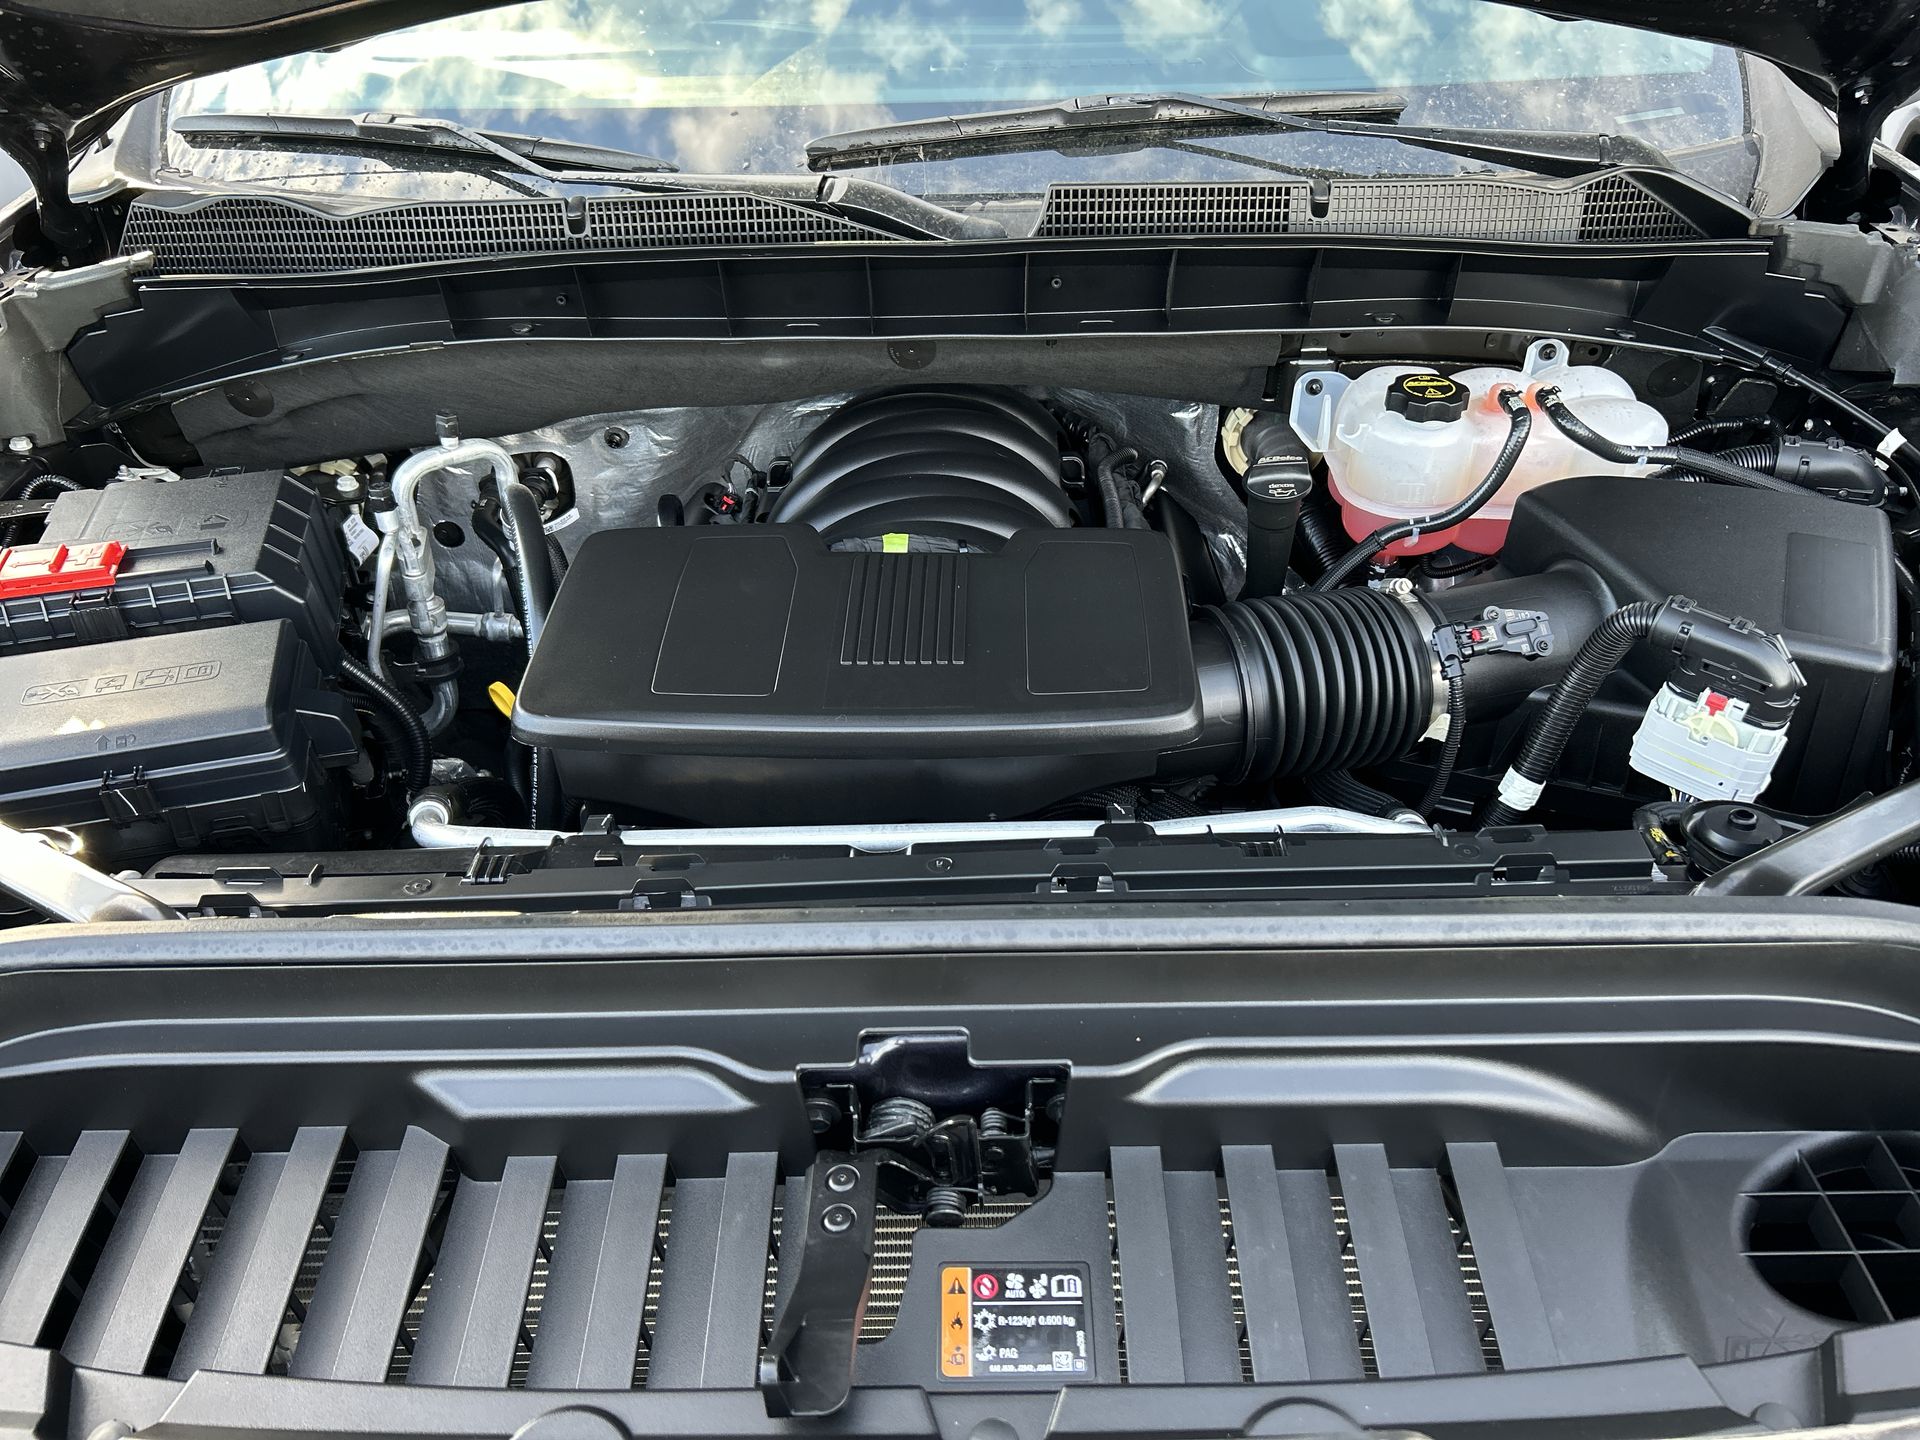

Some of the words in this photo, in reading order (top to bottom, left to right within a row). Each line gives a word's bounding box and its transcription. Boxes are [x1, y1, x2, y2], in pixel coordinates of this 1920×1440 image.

[1005, 1289, 1026, 1298] AUTO
[998, 1315, 1036, 1327] R-1234yf
[1063, 1315, 1076, 1327] kg
[999, 1347, 1019, 1359] PAG
